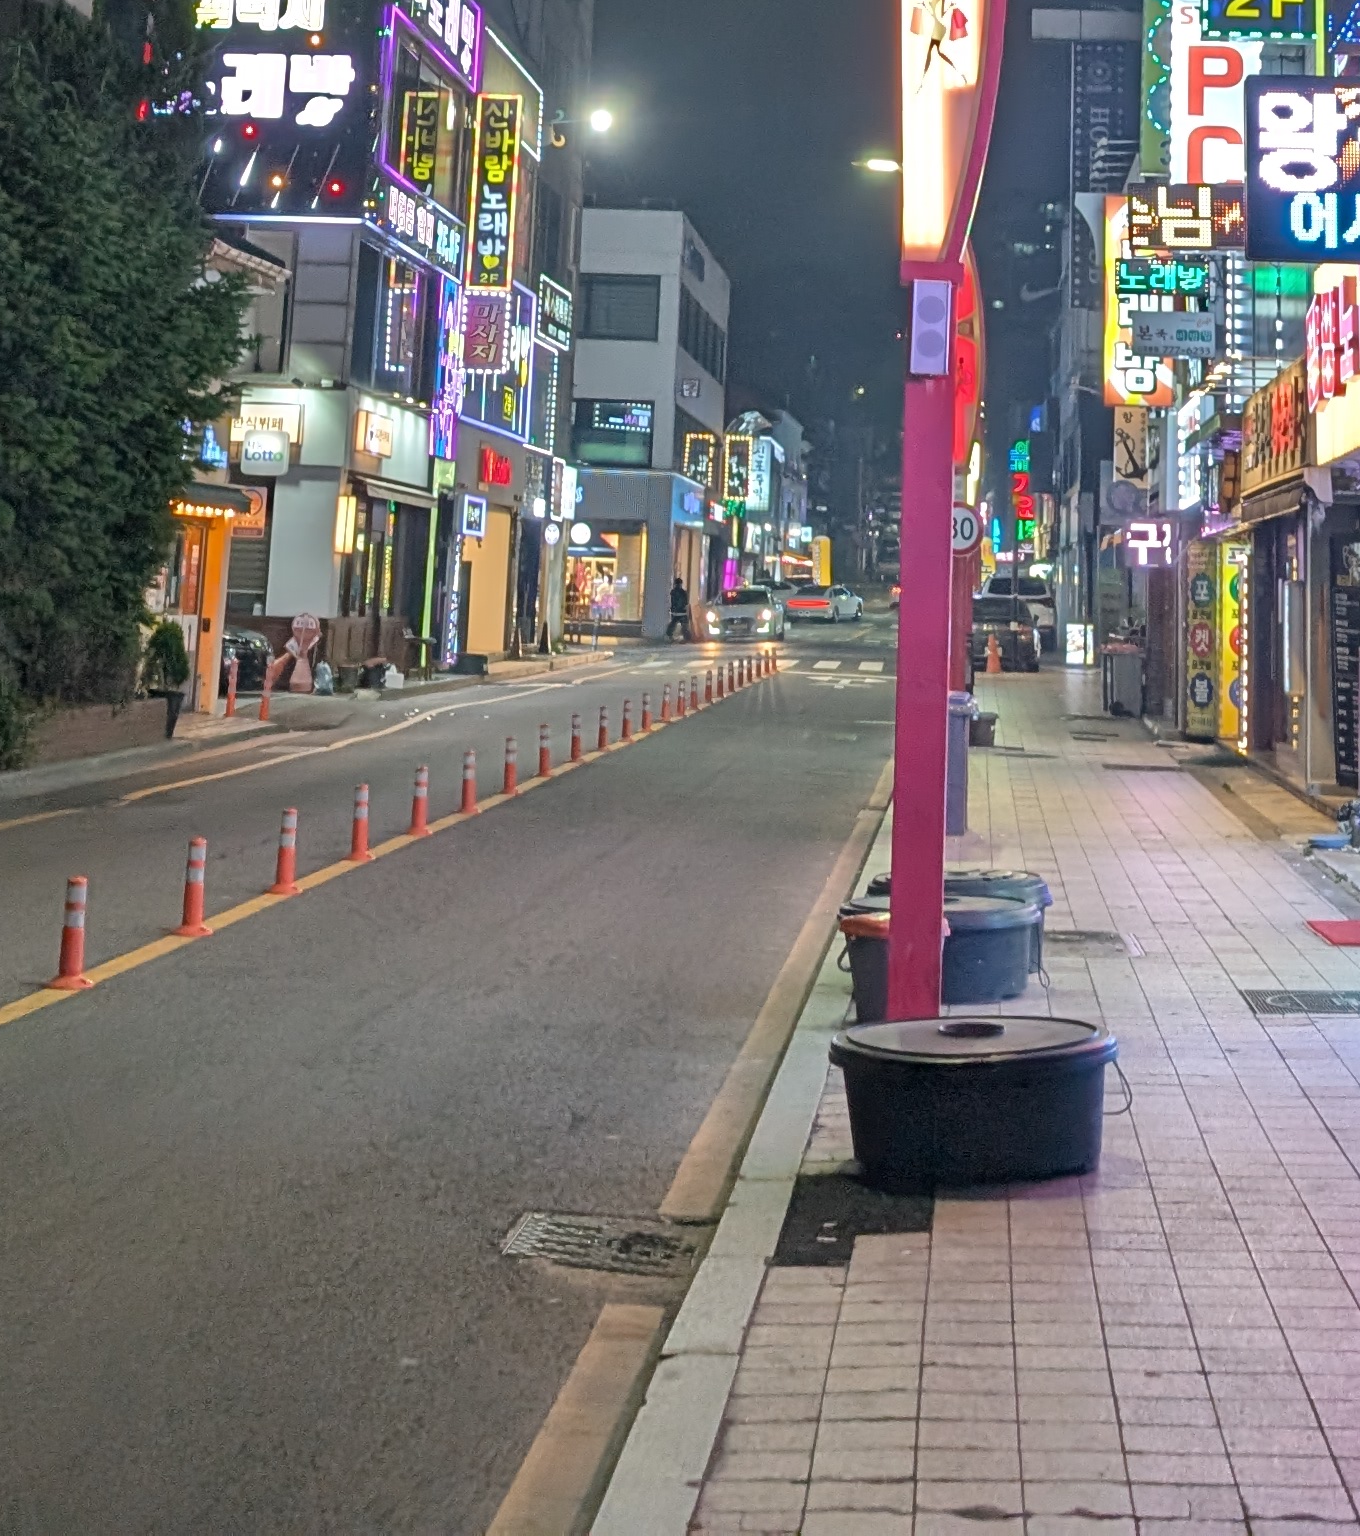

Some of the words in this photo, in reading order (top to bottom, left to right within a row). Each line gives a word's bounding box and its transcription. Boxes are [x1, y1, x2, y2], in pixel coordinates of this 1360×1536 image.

[484, 99, 516, 183] 신바람
[479, 272, 500, 284] 2F
[1119, 262, 1207, 291] 노래방
[468, 303, 502, 363] 마사지
[244, 447, 284, 462] Lotto
